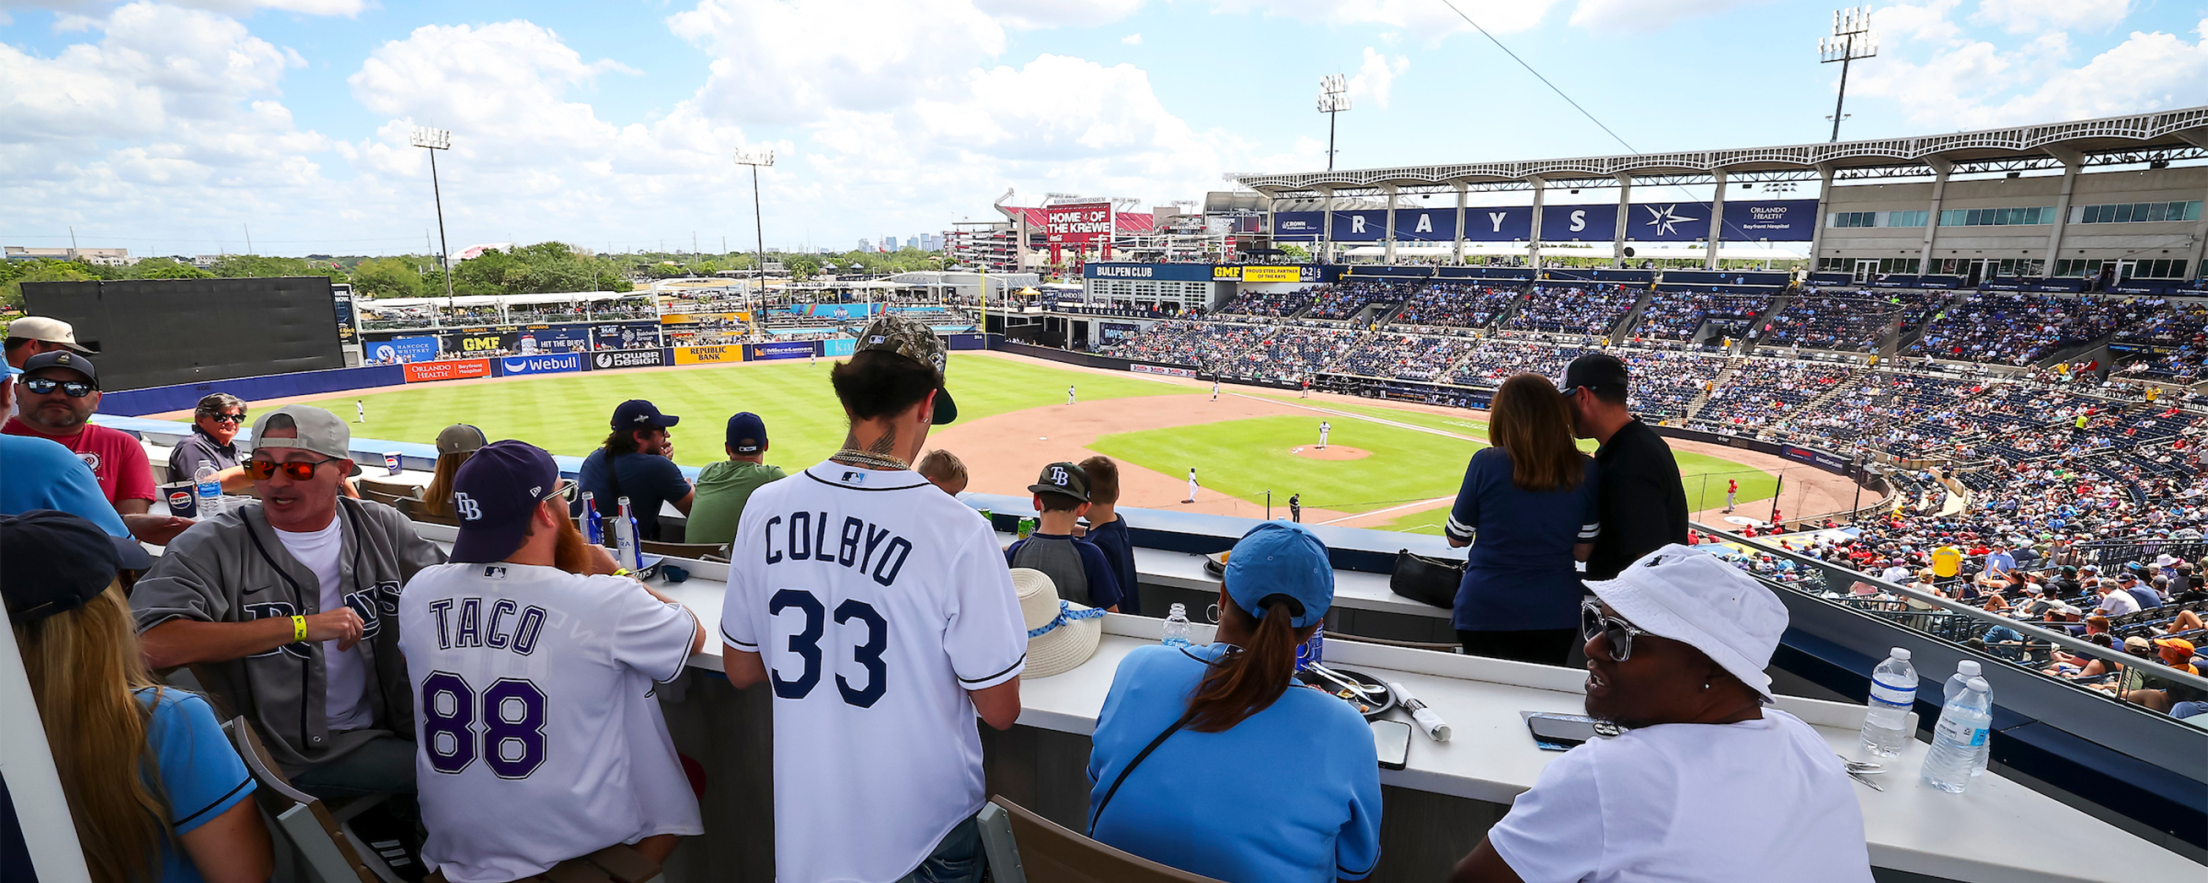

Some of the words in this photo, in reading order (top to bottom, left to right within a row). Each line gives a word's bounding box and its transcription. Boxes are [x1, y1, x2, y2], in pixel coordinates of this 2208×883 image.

[1049, 212, 1081, 223] HOME
[1090, 211, 1106, 222] OF
[1750, 206, 1787, 214] ORLANDO
[1047, 223, 1069, 233] THE
[1070, 222, 1110, 233] KREWE
[1352, 215, 1366, 233] R
[1415, 213, 1433, 233] A
[1488, 212, 1507, 233] Y
[1569, 210, 1586, 232] S
[1096, 266, 1131, 276] BULLPEN
[1132, 266, 1153, 277] CLUB
[1214, 267, 1241, 277] GMF
[463, 336, 500, 351] GMF
[690, 346, 727, 354] REPUBLIC
[529, 356, 577, 371] Webull
[698, 353, 721, 361] BANK
[411, 364, 451, 373] ORLANDO
[1050, 466, 1069, 486] TB
[455, 491, 483, 521] TB
[765, 511, 913, 587] COLBYO
[429, 598, 547, 656] TACO
[769, 588, 888, 709] 33
[420, 669, 548, 780] 88
